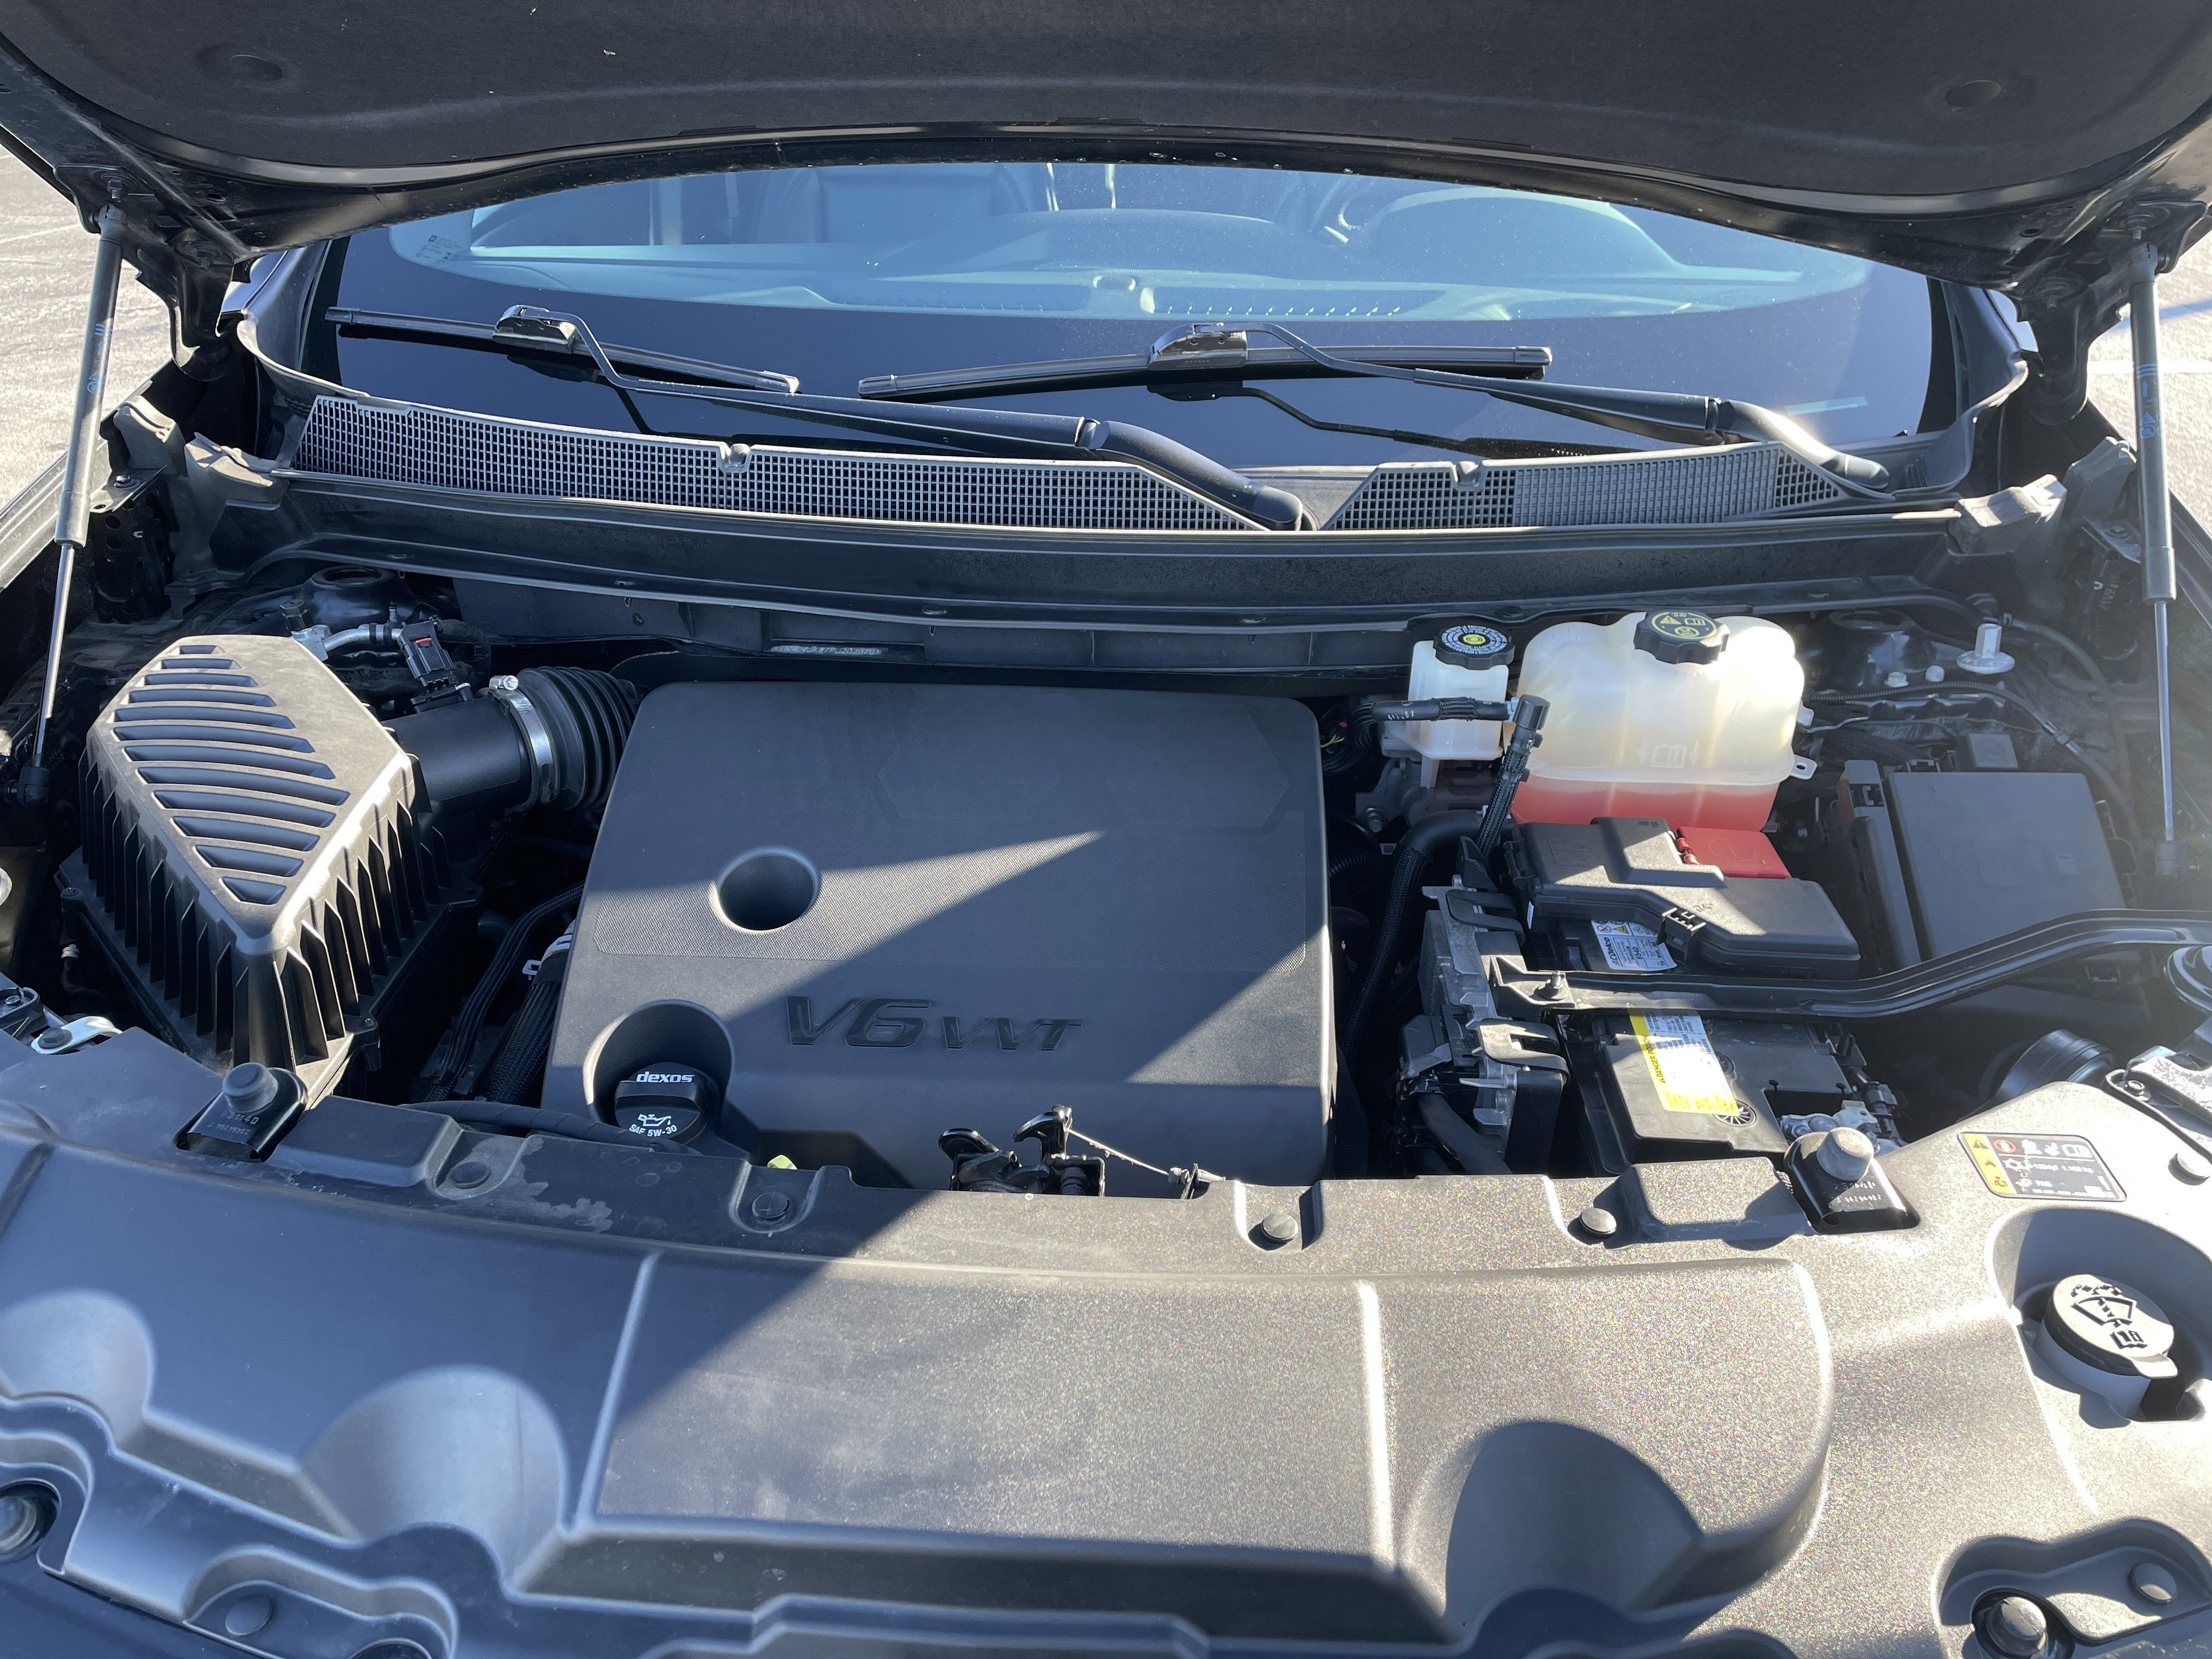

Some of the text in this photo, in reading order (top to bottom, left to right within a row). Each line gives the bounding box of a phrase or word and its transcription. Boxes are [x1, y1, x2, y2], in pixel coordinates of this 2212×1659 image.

[1604, 937, 1620, 966] ACDelco
[786, 996, 1084, 1051] V6 VVT
[636, 1071, 695, 1082] dexos
[647, 1125, 678, 1137] 5W-30
